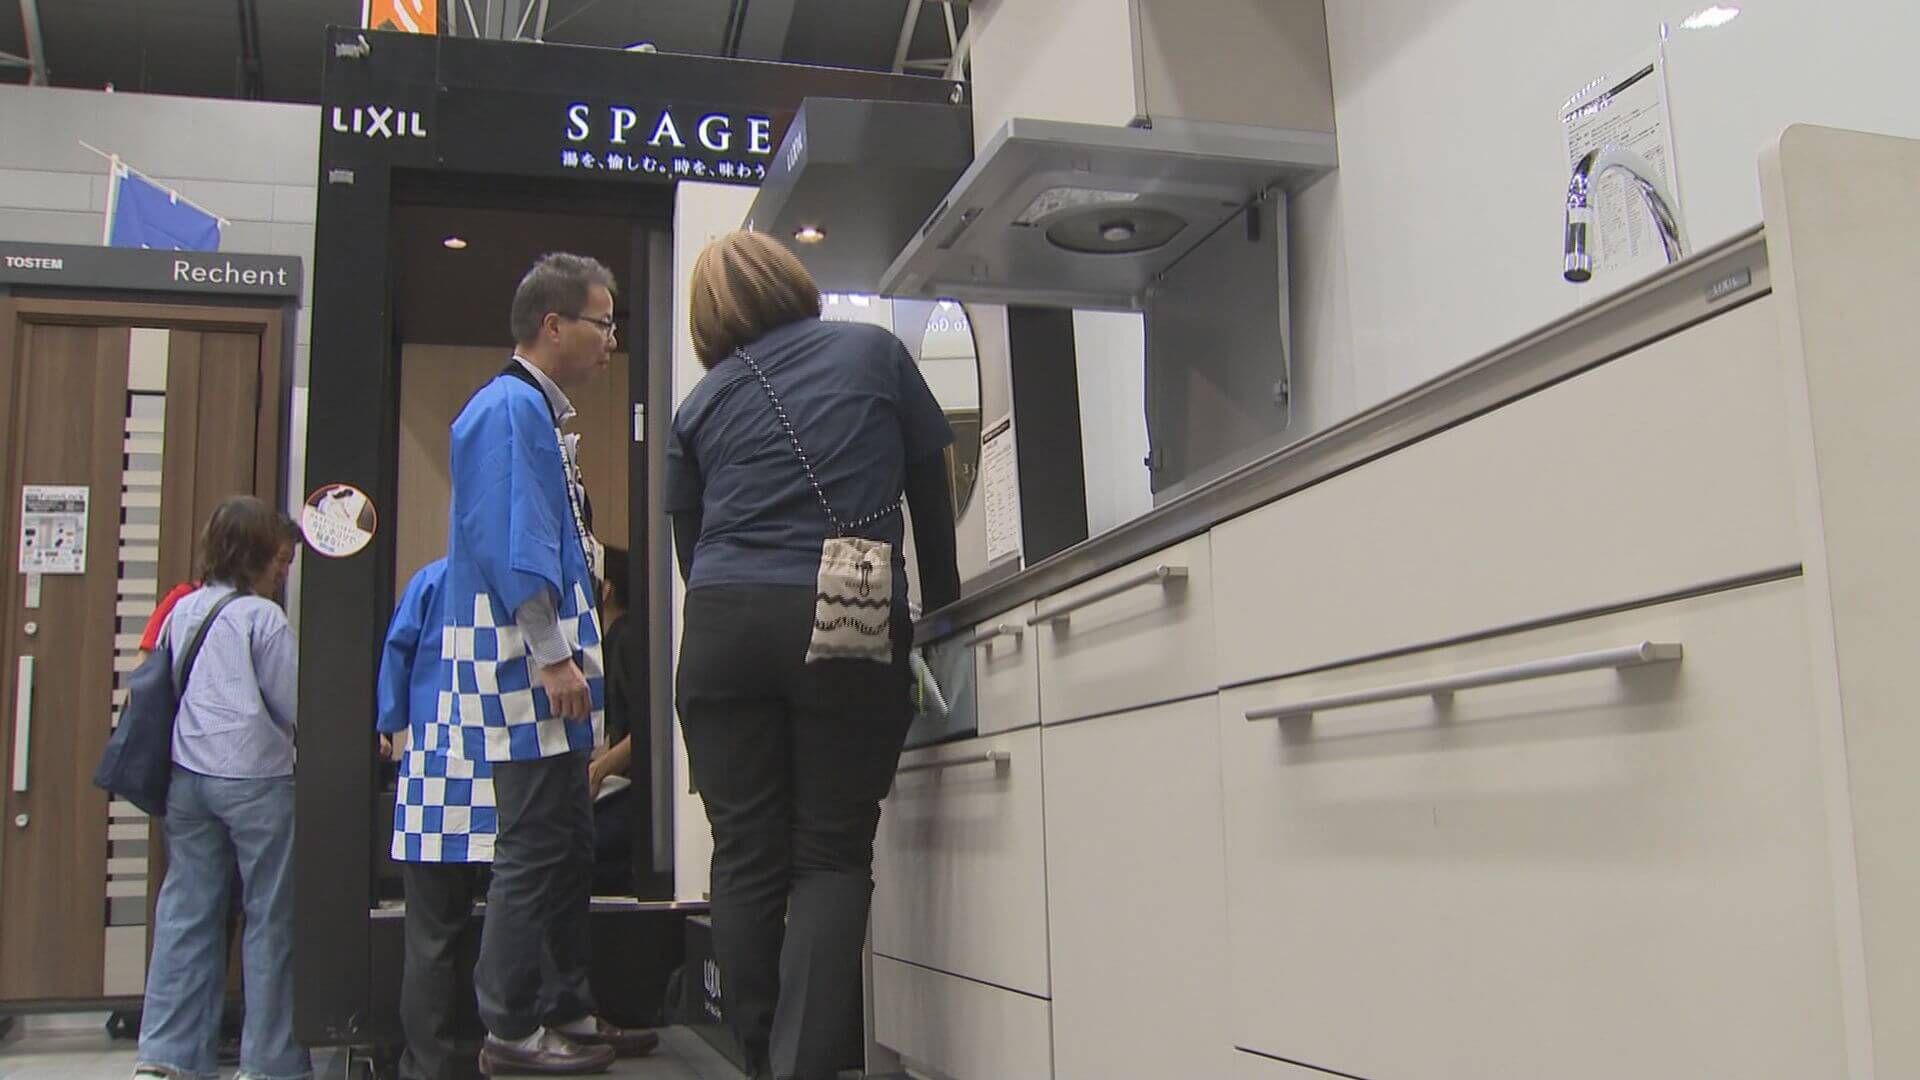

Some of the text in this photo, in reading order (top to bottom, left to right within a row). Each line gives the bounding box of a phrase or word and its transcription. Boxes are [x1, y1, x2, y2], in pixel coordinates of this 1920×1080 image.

[333, 105, 427, 139] LIXIL
[566, 104, 771, 153] SPAGE
[5, 256, 63, 270] TOSTEM
[173, 260, 287, 286] Rechent
